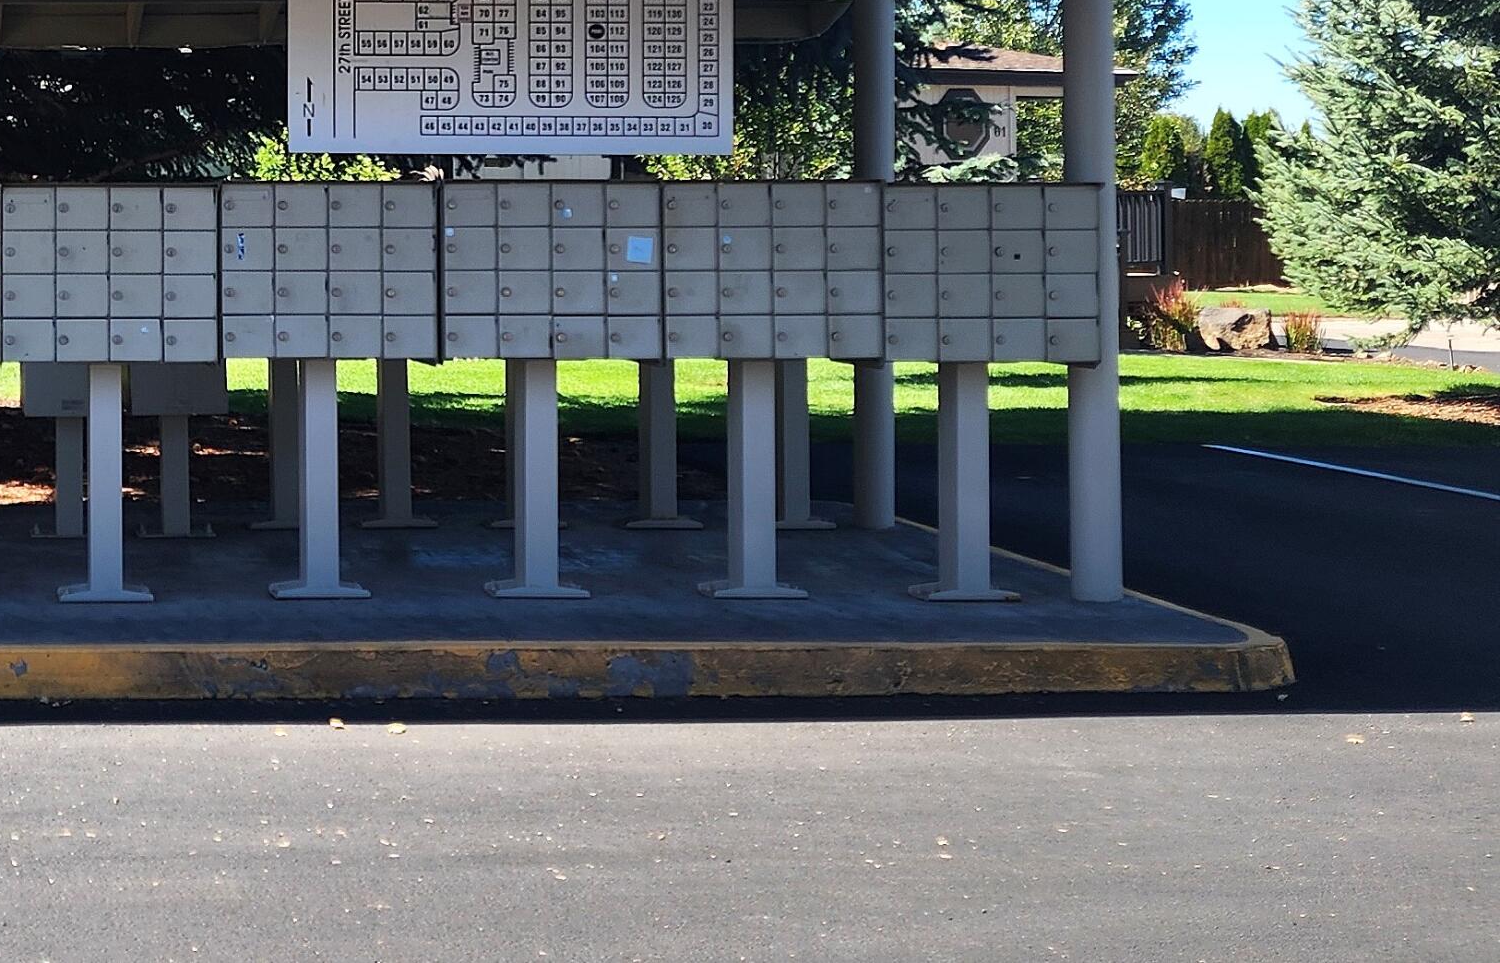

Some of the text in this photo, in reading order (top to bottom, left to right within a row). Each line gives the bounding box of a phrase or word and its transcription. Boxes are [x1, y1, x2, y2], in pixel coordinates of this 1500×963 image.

[419, 6, 429, 14] 62
[479, 9, 490, 17] 70
[499, 9, 509, 17] 77
[556, 10, 565, 18] 95
[648, 10, 662, 18] 119
[668, 10, 682, 18] 130
[419, 21, 428, 29] 61
[480, 28, 488, 36] 71
[499, 26, 509, 34] 76
[536, 27, 546, 35] 85
[556, 27, 566, 35] 94
[610, 27, 624, 35] 112
[668, 27, 681, 35] 129
[703, 34, 713, 42] 25
[362, 39, 371, 48] 55
[377, 40, 387, 48] 56
[394, 40, 404, 48] 57
[411, 40, 421, 48] 58
[427, 40, 437, 48] 59
[444, 40, 454, 48] 60
[555, 45, 565, 53] 93
[590, 45, 605, 53] 104
[610, 45, 624, 53] 111
[648, 45, 661, 53] 121
[703, 48, 713, 56] 26
[338, 44, 350, 73] 27th
[536, 62, 546, 70] 87
[647, 63, 662, 71] 122
[667, 63, 681, 71] 127
[704, 64, 713, 72] 27
[362, 75, 371, 83] 54
[378, 75, 388, 83] 53
[394, 75, 404, 83] 52
[500, 80, 508, 88] 75
[536, 80, 546, 88] 88
[556, 80, 565, 88] 91
[591, 80, 605, 88] 106
[610, 80, 624, 88] 109
[647, 80, 662, 88] 123
[704, 81, 713, 89] 28
[555, 95, 566, 103] 90
[590, 95, 605, 103] 107
[610, 95, 624, 103] 108
[647, 95, 662, 103] 124
[667, 95, 681, 103] 125
[425, 122, 434, 130] 46
[542, 123, 552, 131] 39
[560, 123, 569, 131] 38
[577, 123, 586, 131] 37
[593, 123, 602, 131] 36
[627, 123, 637, 131] 34
